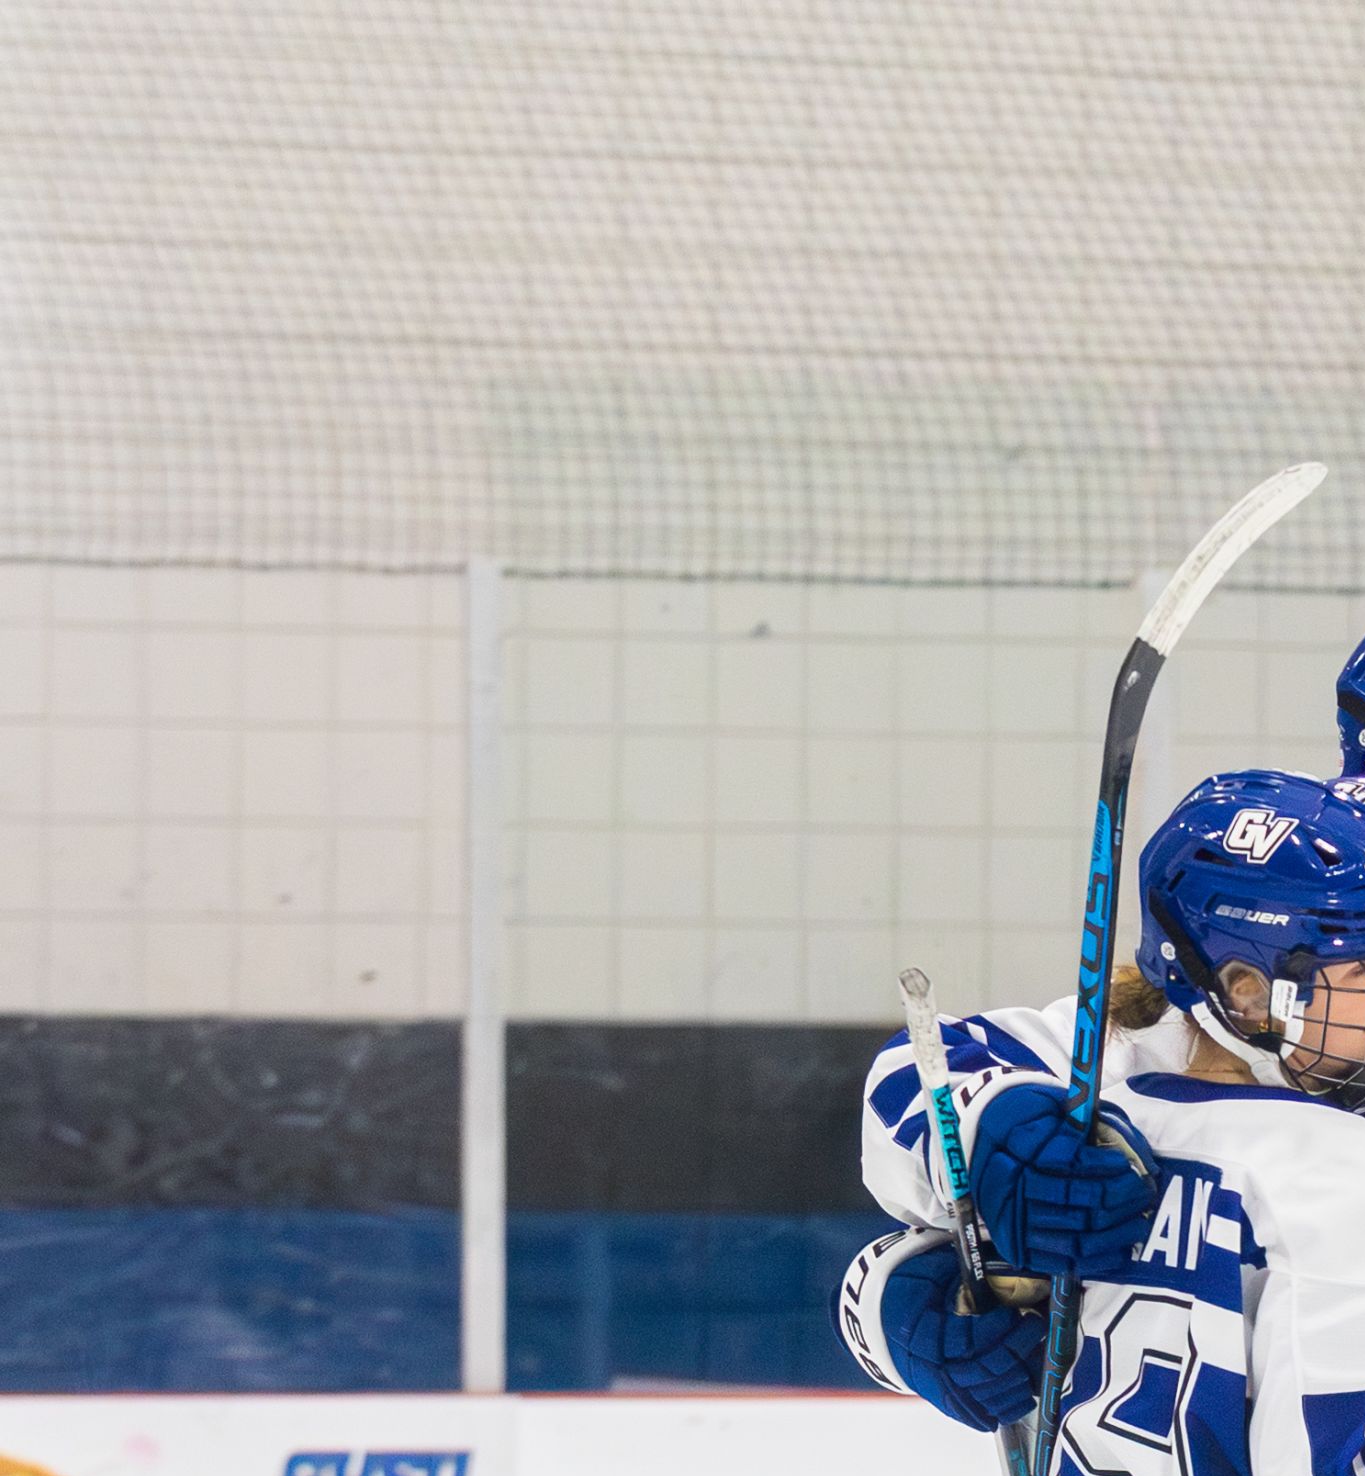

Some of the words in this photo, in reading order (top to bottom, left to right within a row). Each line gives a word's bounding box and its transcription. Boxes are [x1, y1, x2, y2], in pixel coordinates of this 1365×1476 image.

[1223, 808, 1299, 864] GV
[1215, 904, 1290, 926] BAUER
[843, 1228, 908, 1392] BAUE
